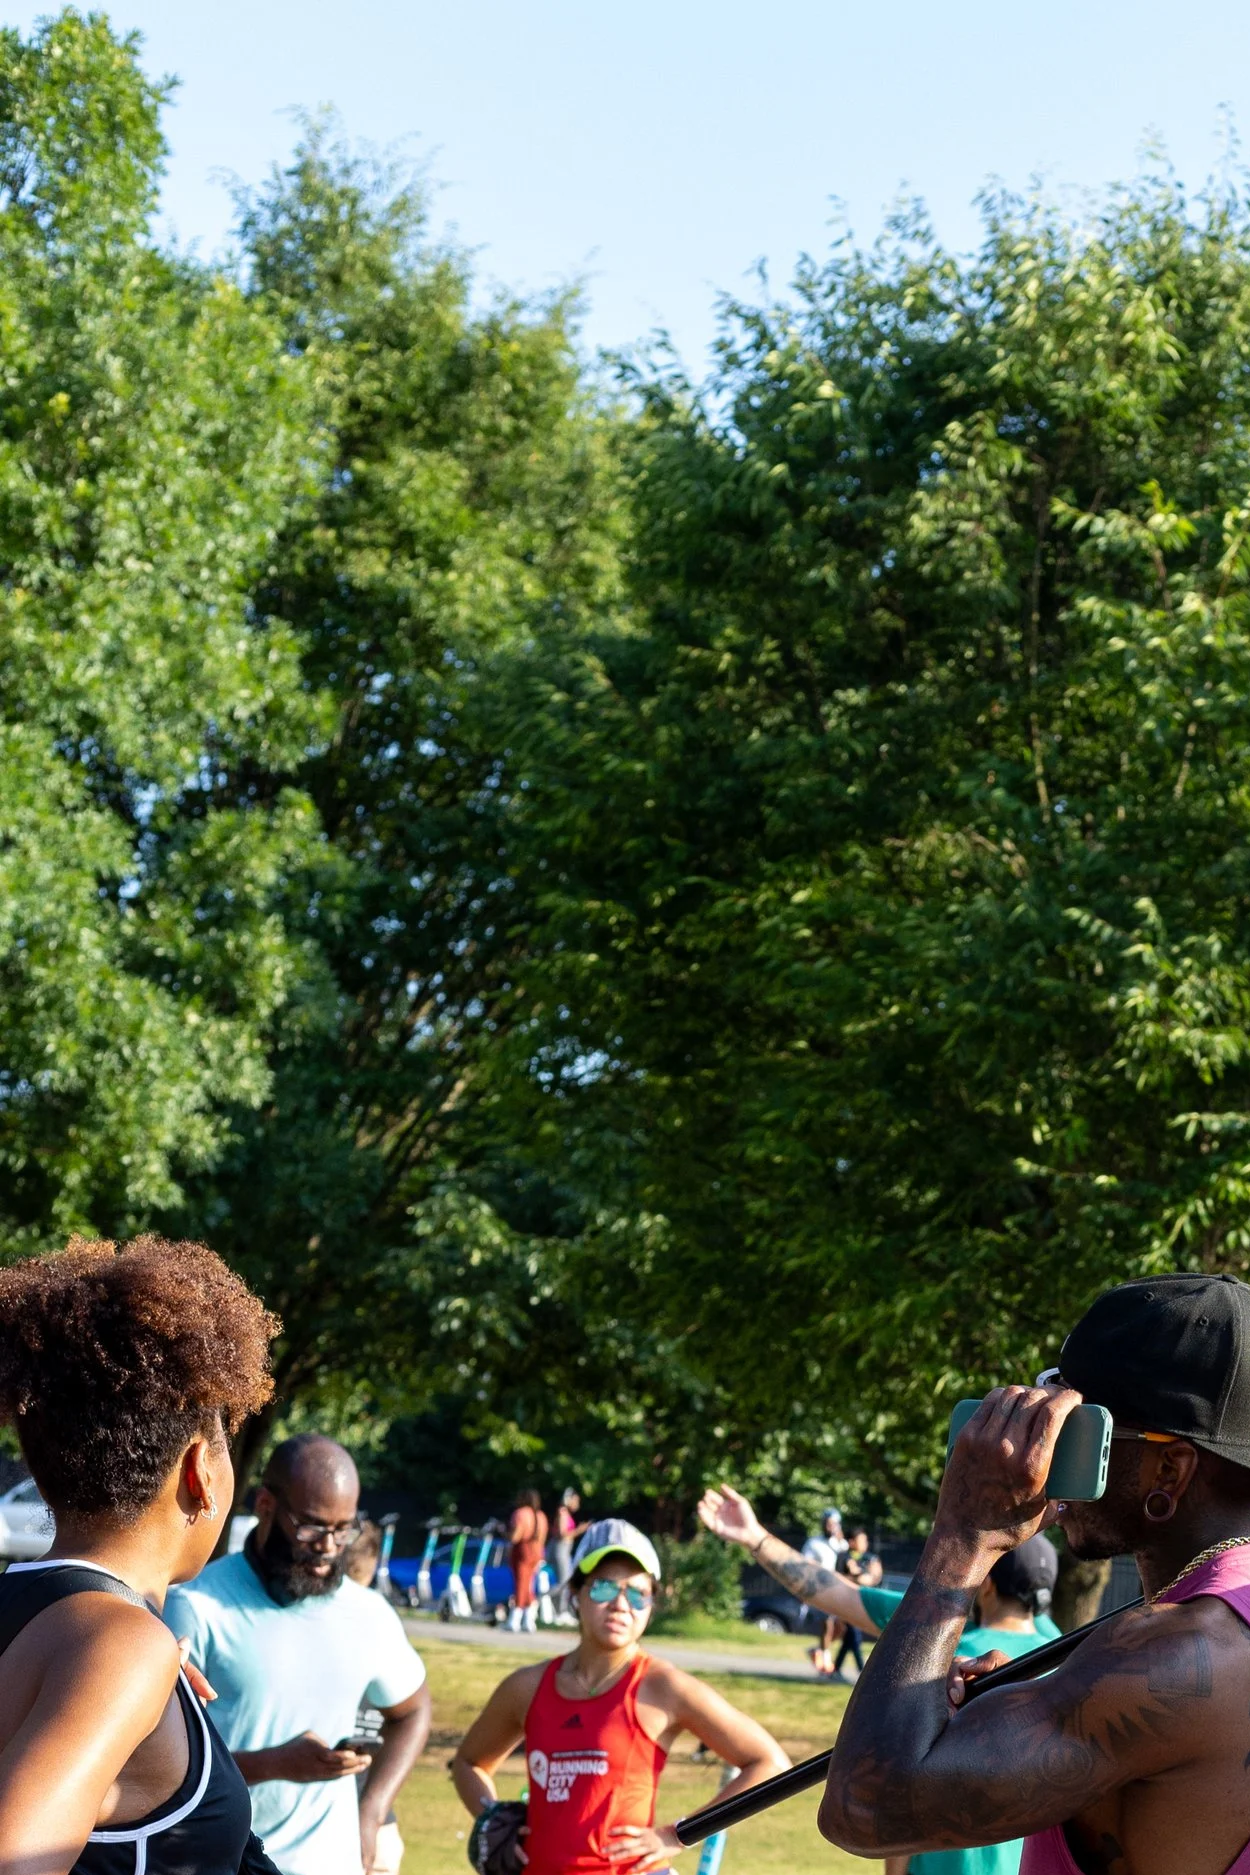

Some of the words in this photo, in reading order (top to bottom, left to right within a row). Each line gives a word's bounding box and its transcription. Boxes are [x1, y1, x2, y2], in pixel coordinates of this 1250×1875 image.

[549, 1760, 609, 1776] RUNNING
[548, 1774, 577, 1789] CITY
[546, 1787, 570, 1802] USA
